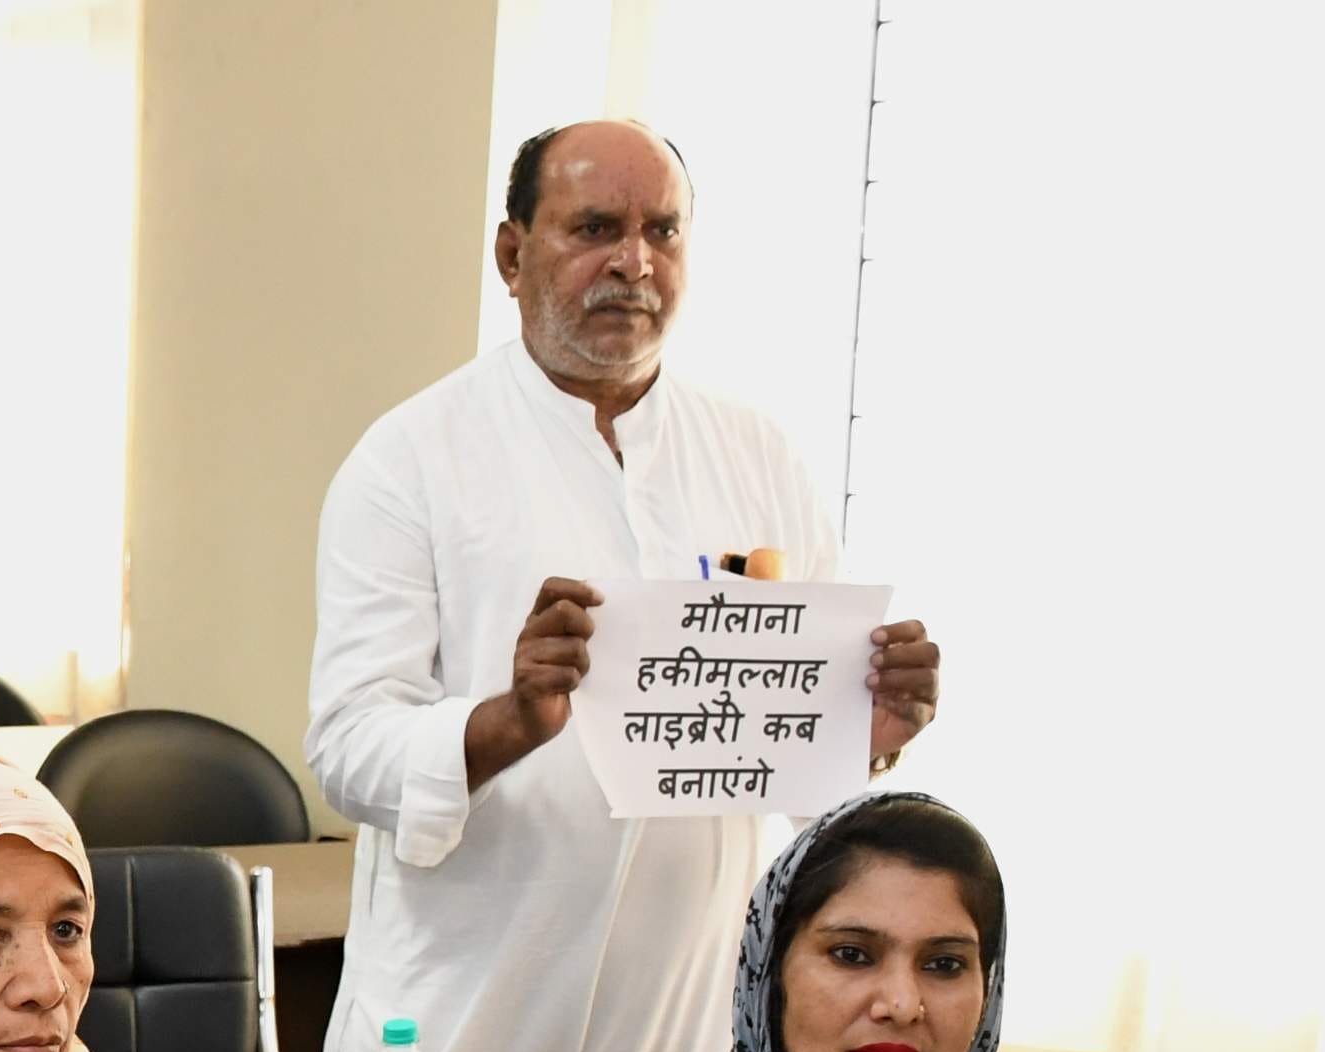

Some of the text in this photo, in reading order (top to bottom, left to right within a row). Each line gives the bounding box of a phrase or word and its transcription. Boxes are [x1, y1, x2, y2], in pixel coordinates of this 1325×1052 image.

[681, 593, 806, 634] मौलाना
[637, 646, 828, 705] हकीमुल्लाह
[624, 703, 822, 749] लाइब्रेरी कब
[658, 755, 775, 800] बनाएंगे
